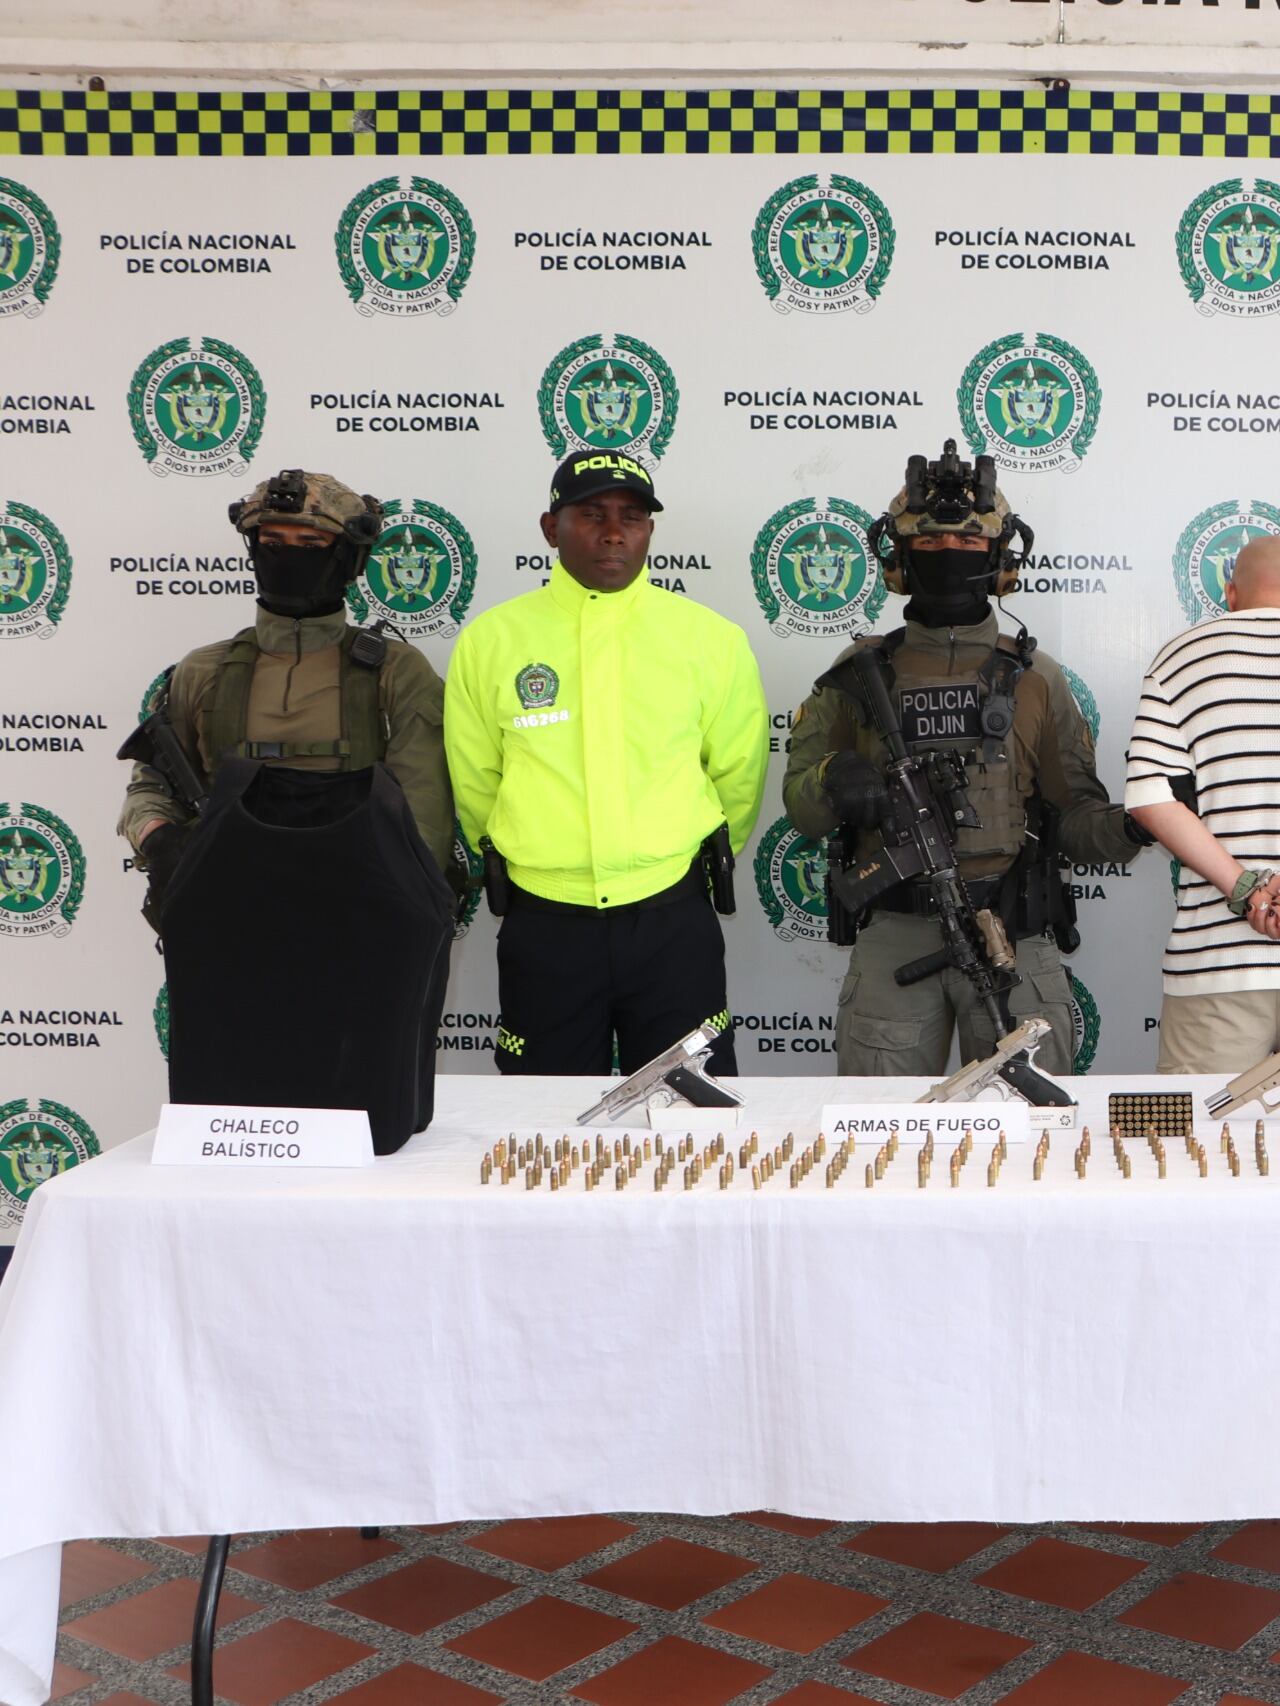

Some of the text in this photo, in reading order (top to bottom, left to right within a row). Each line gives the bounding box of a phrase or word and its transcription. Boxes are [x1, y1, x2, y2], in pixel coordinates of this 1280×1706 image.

[1242, 194, 1258, 202] DE
[399, 192, 415, 200] DE
[425, 198, 459, 254] COLOMBIA
[844, 196, 878, 252] COLOMBIA
[100, 230, 297, 251] POLICÍA NACIONAL
[514, 228, 713, 248] POLICÍA NACIONAL
[935, 226, 1136, 248] POLICÍA NACIONAL
[126, 257, 272, 274] DE COLOMBIA
[540, 254, 687, 271] DE COLOMBIA
[961, 254, 1110, 270] DE COLOMBIA
[406, 267, 453, 300] NACIONAL
[824, 264, 873, 298] NACIONAL
[370, 297, 394, 313] DIOS
[406, 297, 442, 314] PATRIA
[823, 294, 861, 311] PATRIA
[1211, 298, 1236, 313] DIOS
[190, 353, 206, 361] DE
[216, 359, 250, 415] COLOMBIA
[310, 389, 505, 410] POLICÍA NACIONAL
[724, 387, 924, 407] POLICÍA NACIONAL
[1147, 389, 1231, 409] POLICÍA
[0, 419, 71, 434] OMBIA
[336, 416, 480, 433] DE COLOMBIA
[750, 414, 898, 430] DE COLOMBIA
[1173, 416, 1202, 432] DE
[199, 427, 246, 461] NACIONAL
[164, 457, 189, 472] DIOS
[200, 458, 235, 474] PATRIA
[109, 553, 257, 573] POLICÍA NACIO
[647, 555, 711, 570] IONAL
[1021, 554, 1133, 571] NACIONAL
[136, 580, 259, 596] DE COLOMB
[1015, 578, 1108, 594] LOMBIA
[902, 690, 976, 713] POLICIA
[2, 714, 108, 730] NACIONAL
[916, 714, 965, 736] DIJIN
[0, 737, 85, 752] LOMBIA
[19, 1010, 123, 1026] NACIONAL
[732, 1012, 814, 1031] POLICÍA
[758, 1038, 786, 1053] DE
[209, 1118, 300, 1135] CHALECO
[833, 1118, 1004, 1133] ARMAS DE FUEGO
[201, 1139, 301, 1159] BALÍSTICO
